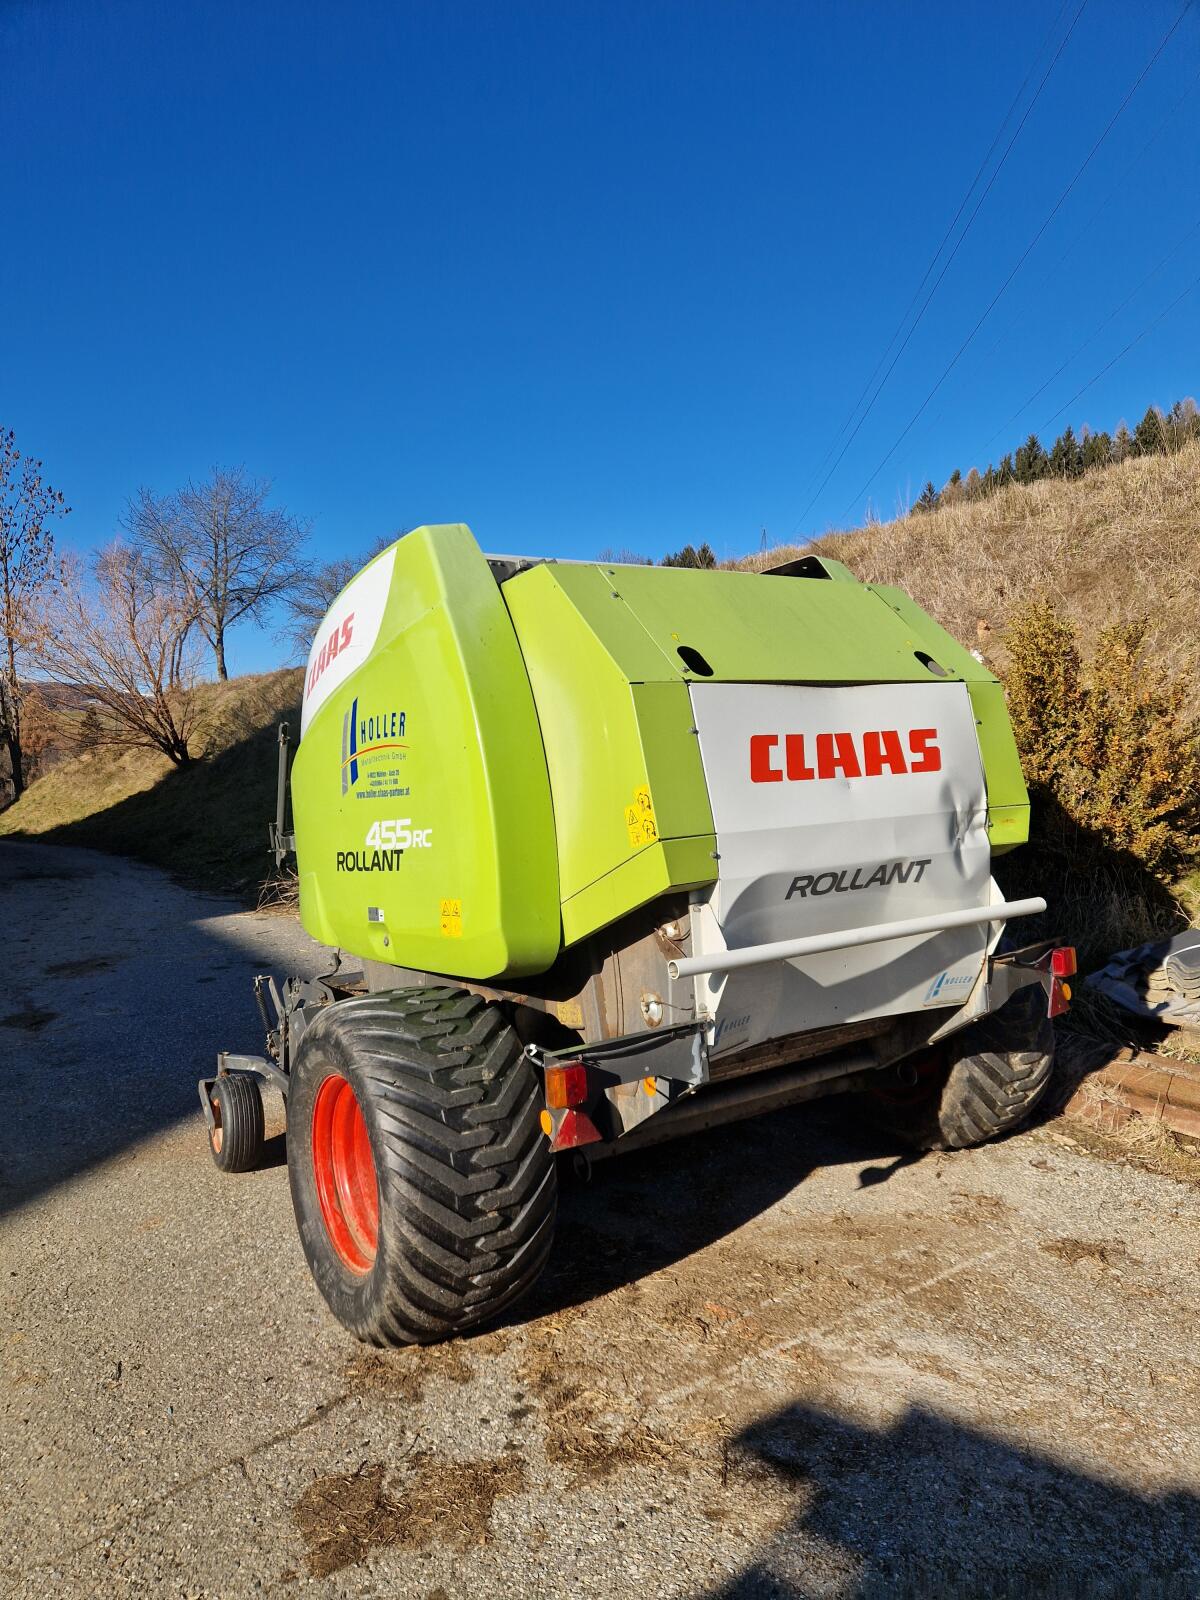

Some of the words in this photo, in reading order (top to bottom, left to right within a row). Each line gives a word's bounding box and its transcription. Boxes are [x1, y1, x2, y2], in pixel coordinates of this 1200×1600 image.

[749, 728, 942, 784] CLAAS
[336, 849, 404, 872] ROLLANT
[784, 859, 932, 901] ROLLANT
